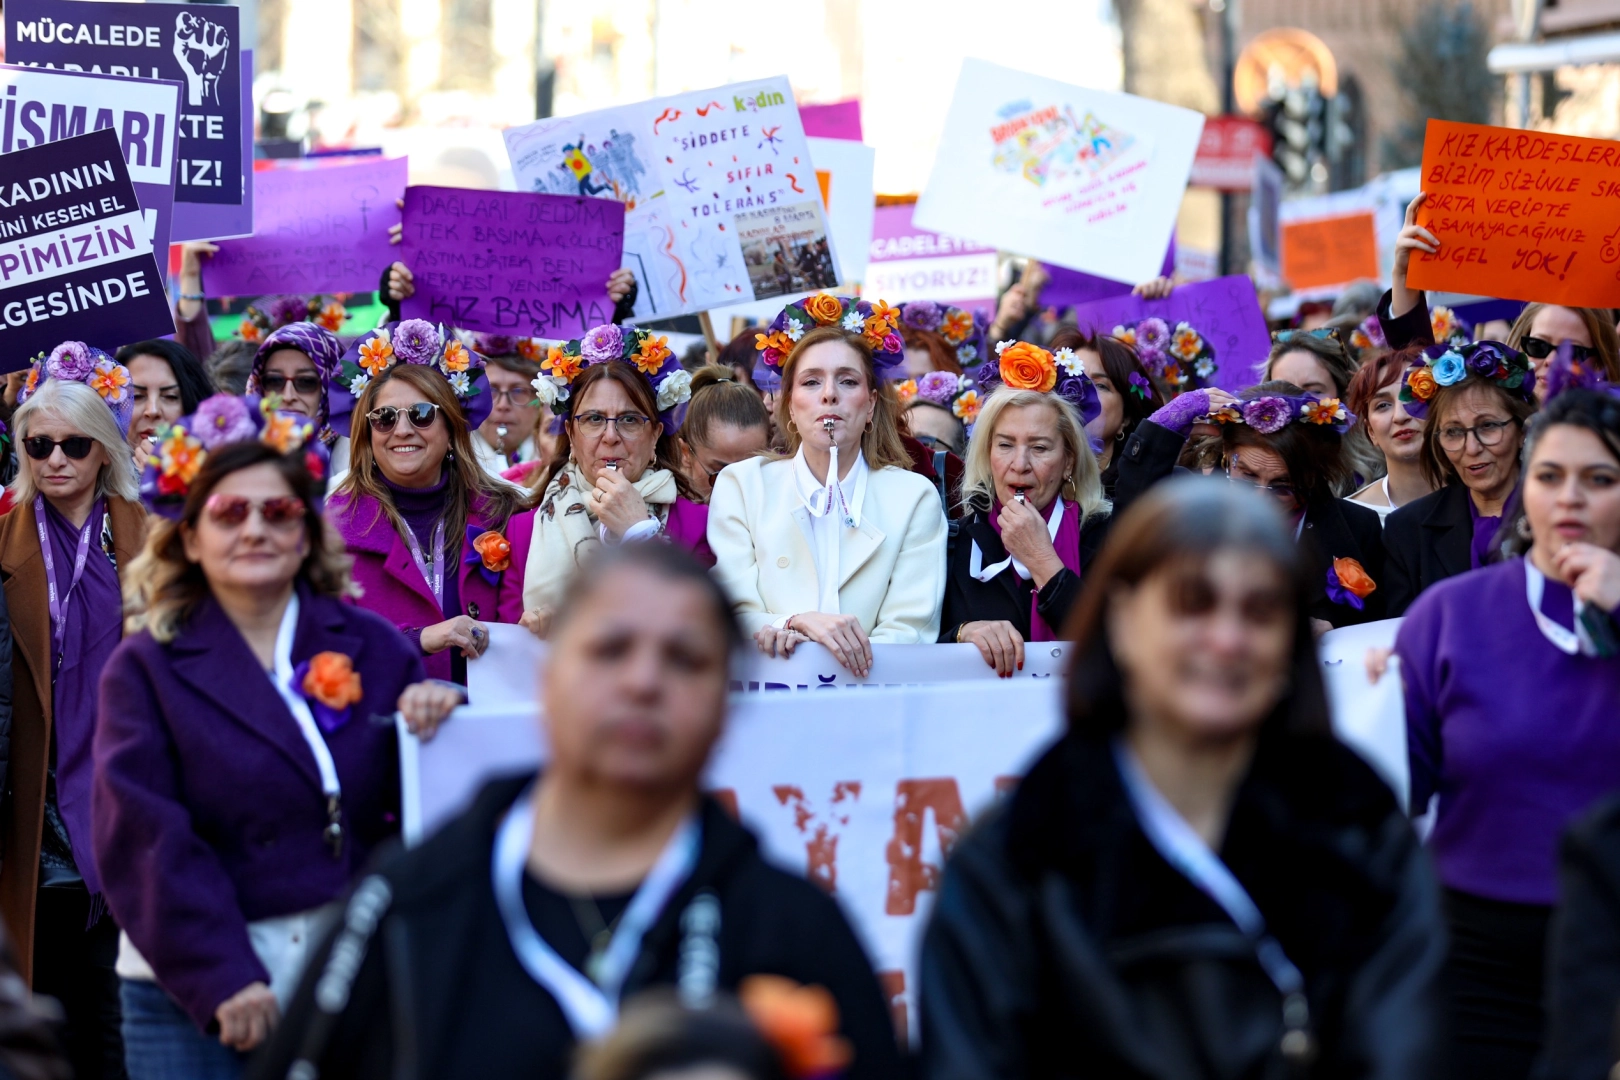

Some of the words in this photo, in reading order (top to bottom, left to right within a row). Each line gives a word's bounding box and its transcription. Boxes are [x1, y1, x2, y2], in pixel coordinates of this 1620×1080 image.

[16, 17, 161, 48] MÜCALEDE
[1438, 131, 1479, 158] KIZ
[726, 162, 774, 184] SIFIR
[1427, 161, 1495, 194] BİZİM
[1499, 169, 1581, 193] SİZİNLE
[32, 201, 97, 231] KESEN
[102, 195, 126, 214] EL
[422, 194, 508, 220] DAĞLARI
[526, 199, 606, 229] DELDİM
[1425, 192, 1475, 214] SIRTA
[1485, 197, 1571, 218] VERİPTE
[413, 223, 460, 241] TEK
[0, 224, 136, 281] PİMİZİN
[541, 256, 585, 276] BEN
[1511, 247, 1578, 281] YOK!
[429, 295, 481, 324] KIZ
[491, 295, 608, 336] BAŞIMA
